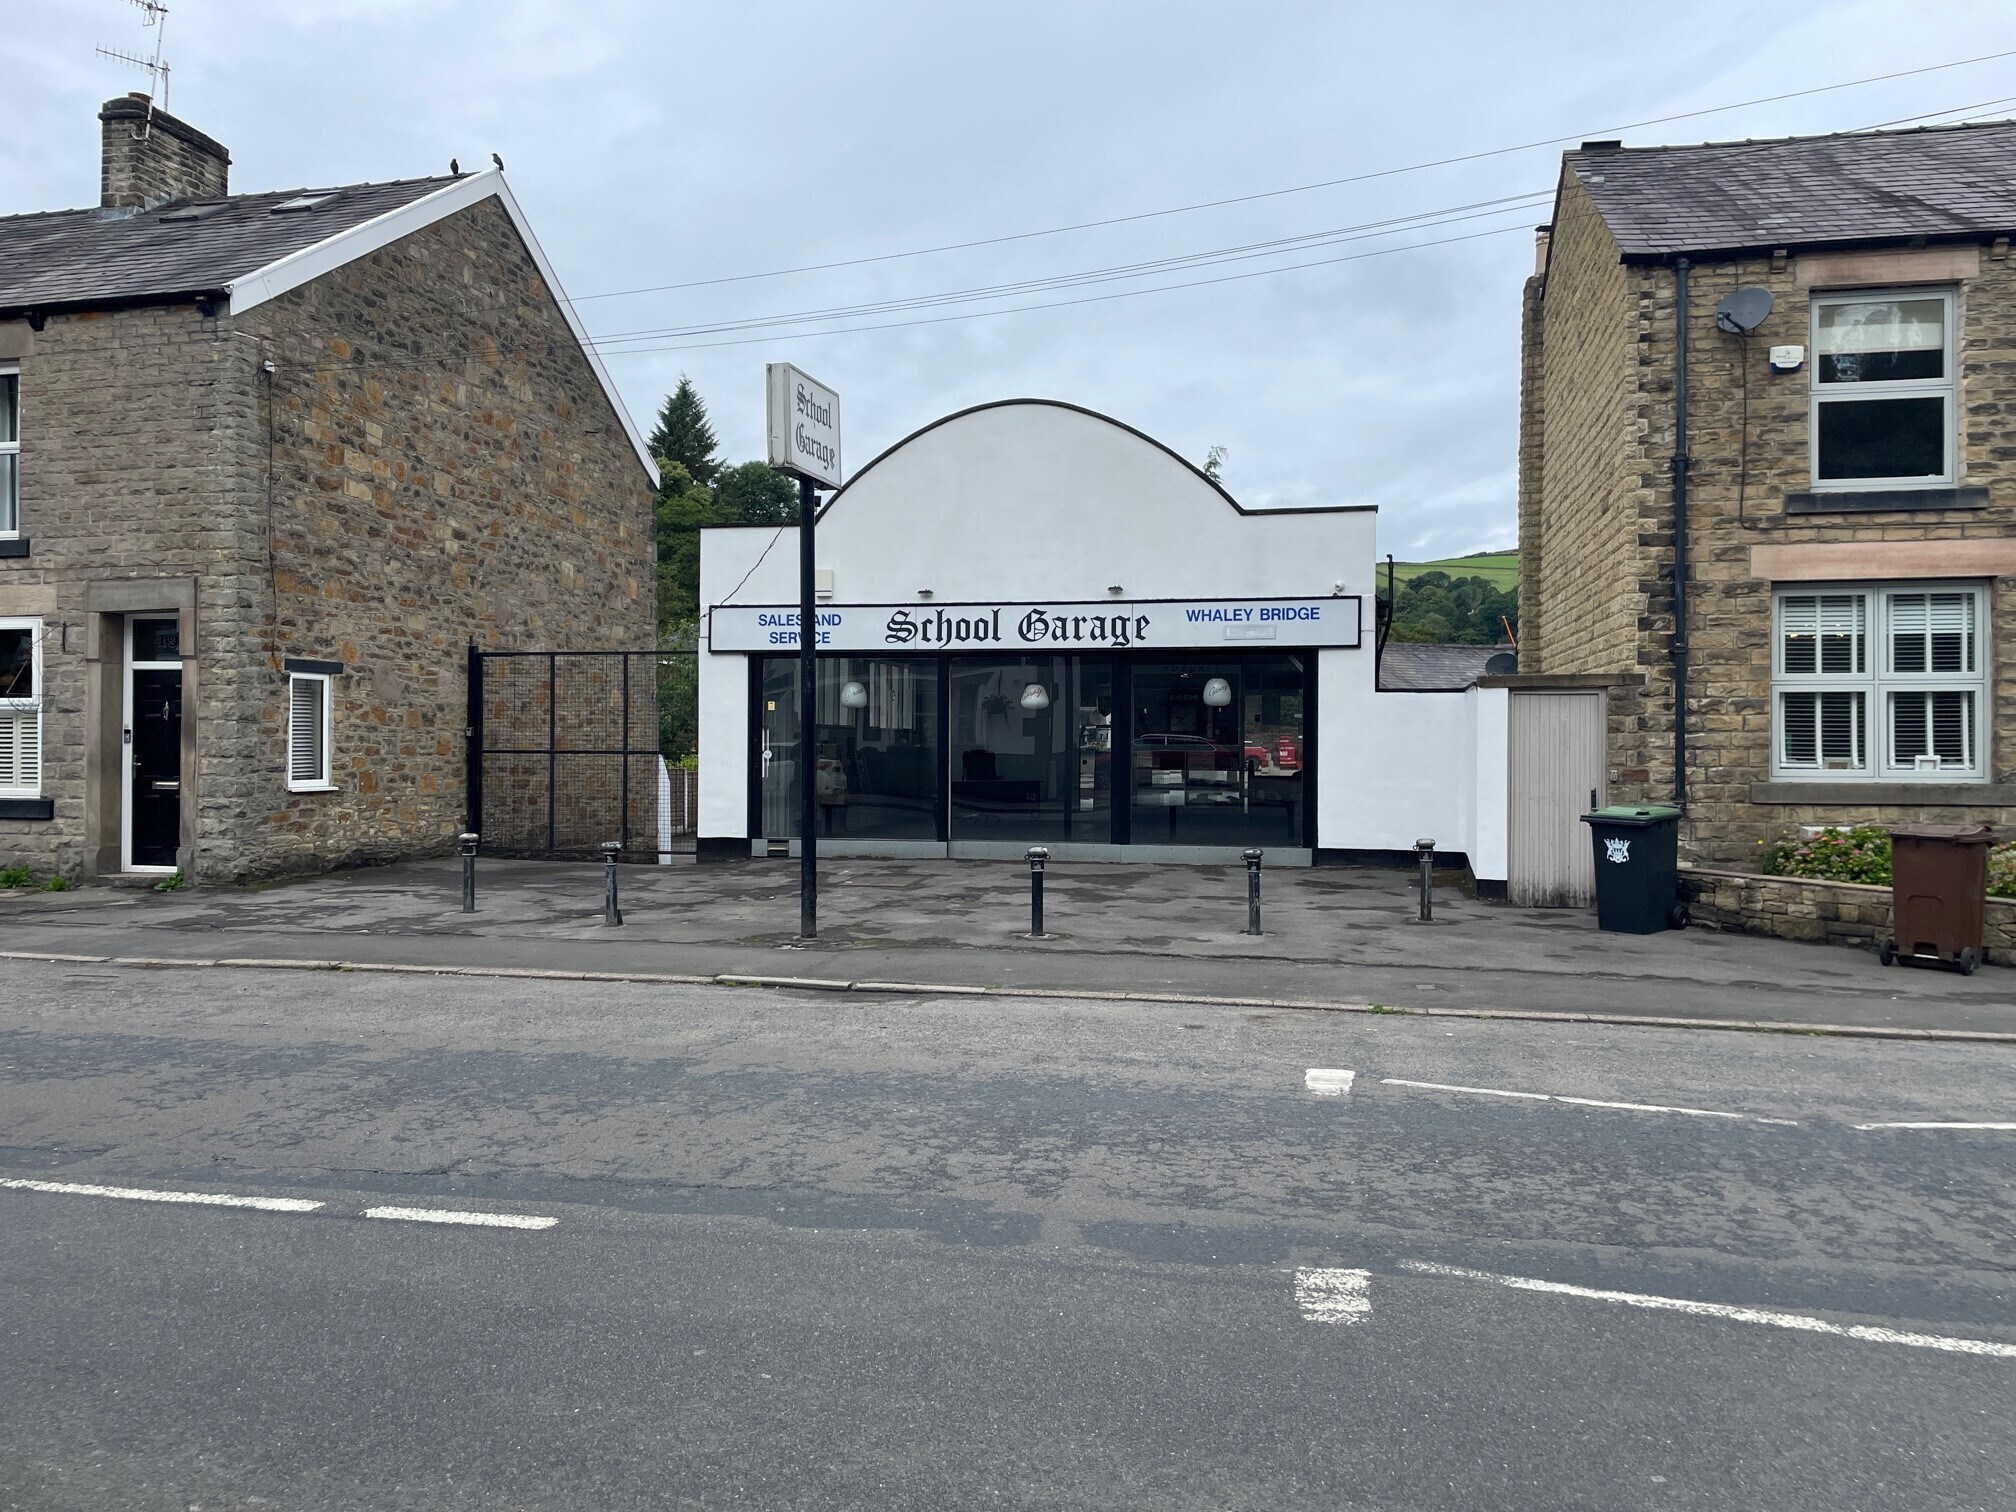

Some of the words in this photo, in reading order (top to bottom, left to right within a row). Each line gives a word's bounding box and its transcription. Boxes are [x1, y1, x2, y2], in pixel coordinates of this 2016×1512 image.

[796, 383, 832, 430] School
[796, 422, 836, 470] Garage
[758, 614, 801, 627] SALES
[885, 608, 1002, 649] School
[1018, 608, 1151, 647] Garage
[1186, 609, 1253, 622] WHALEY
[1260, 607, 1320, 621] BRIDGE
[769, 632, 831, 644] SERCE
